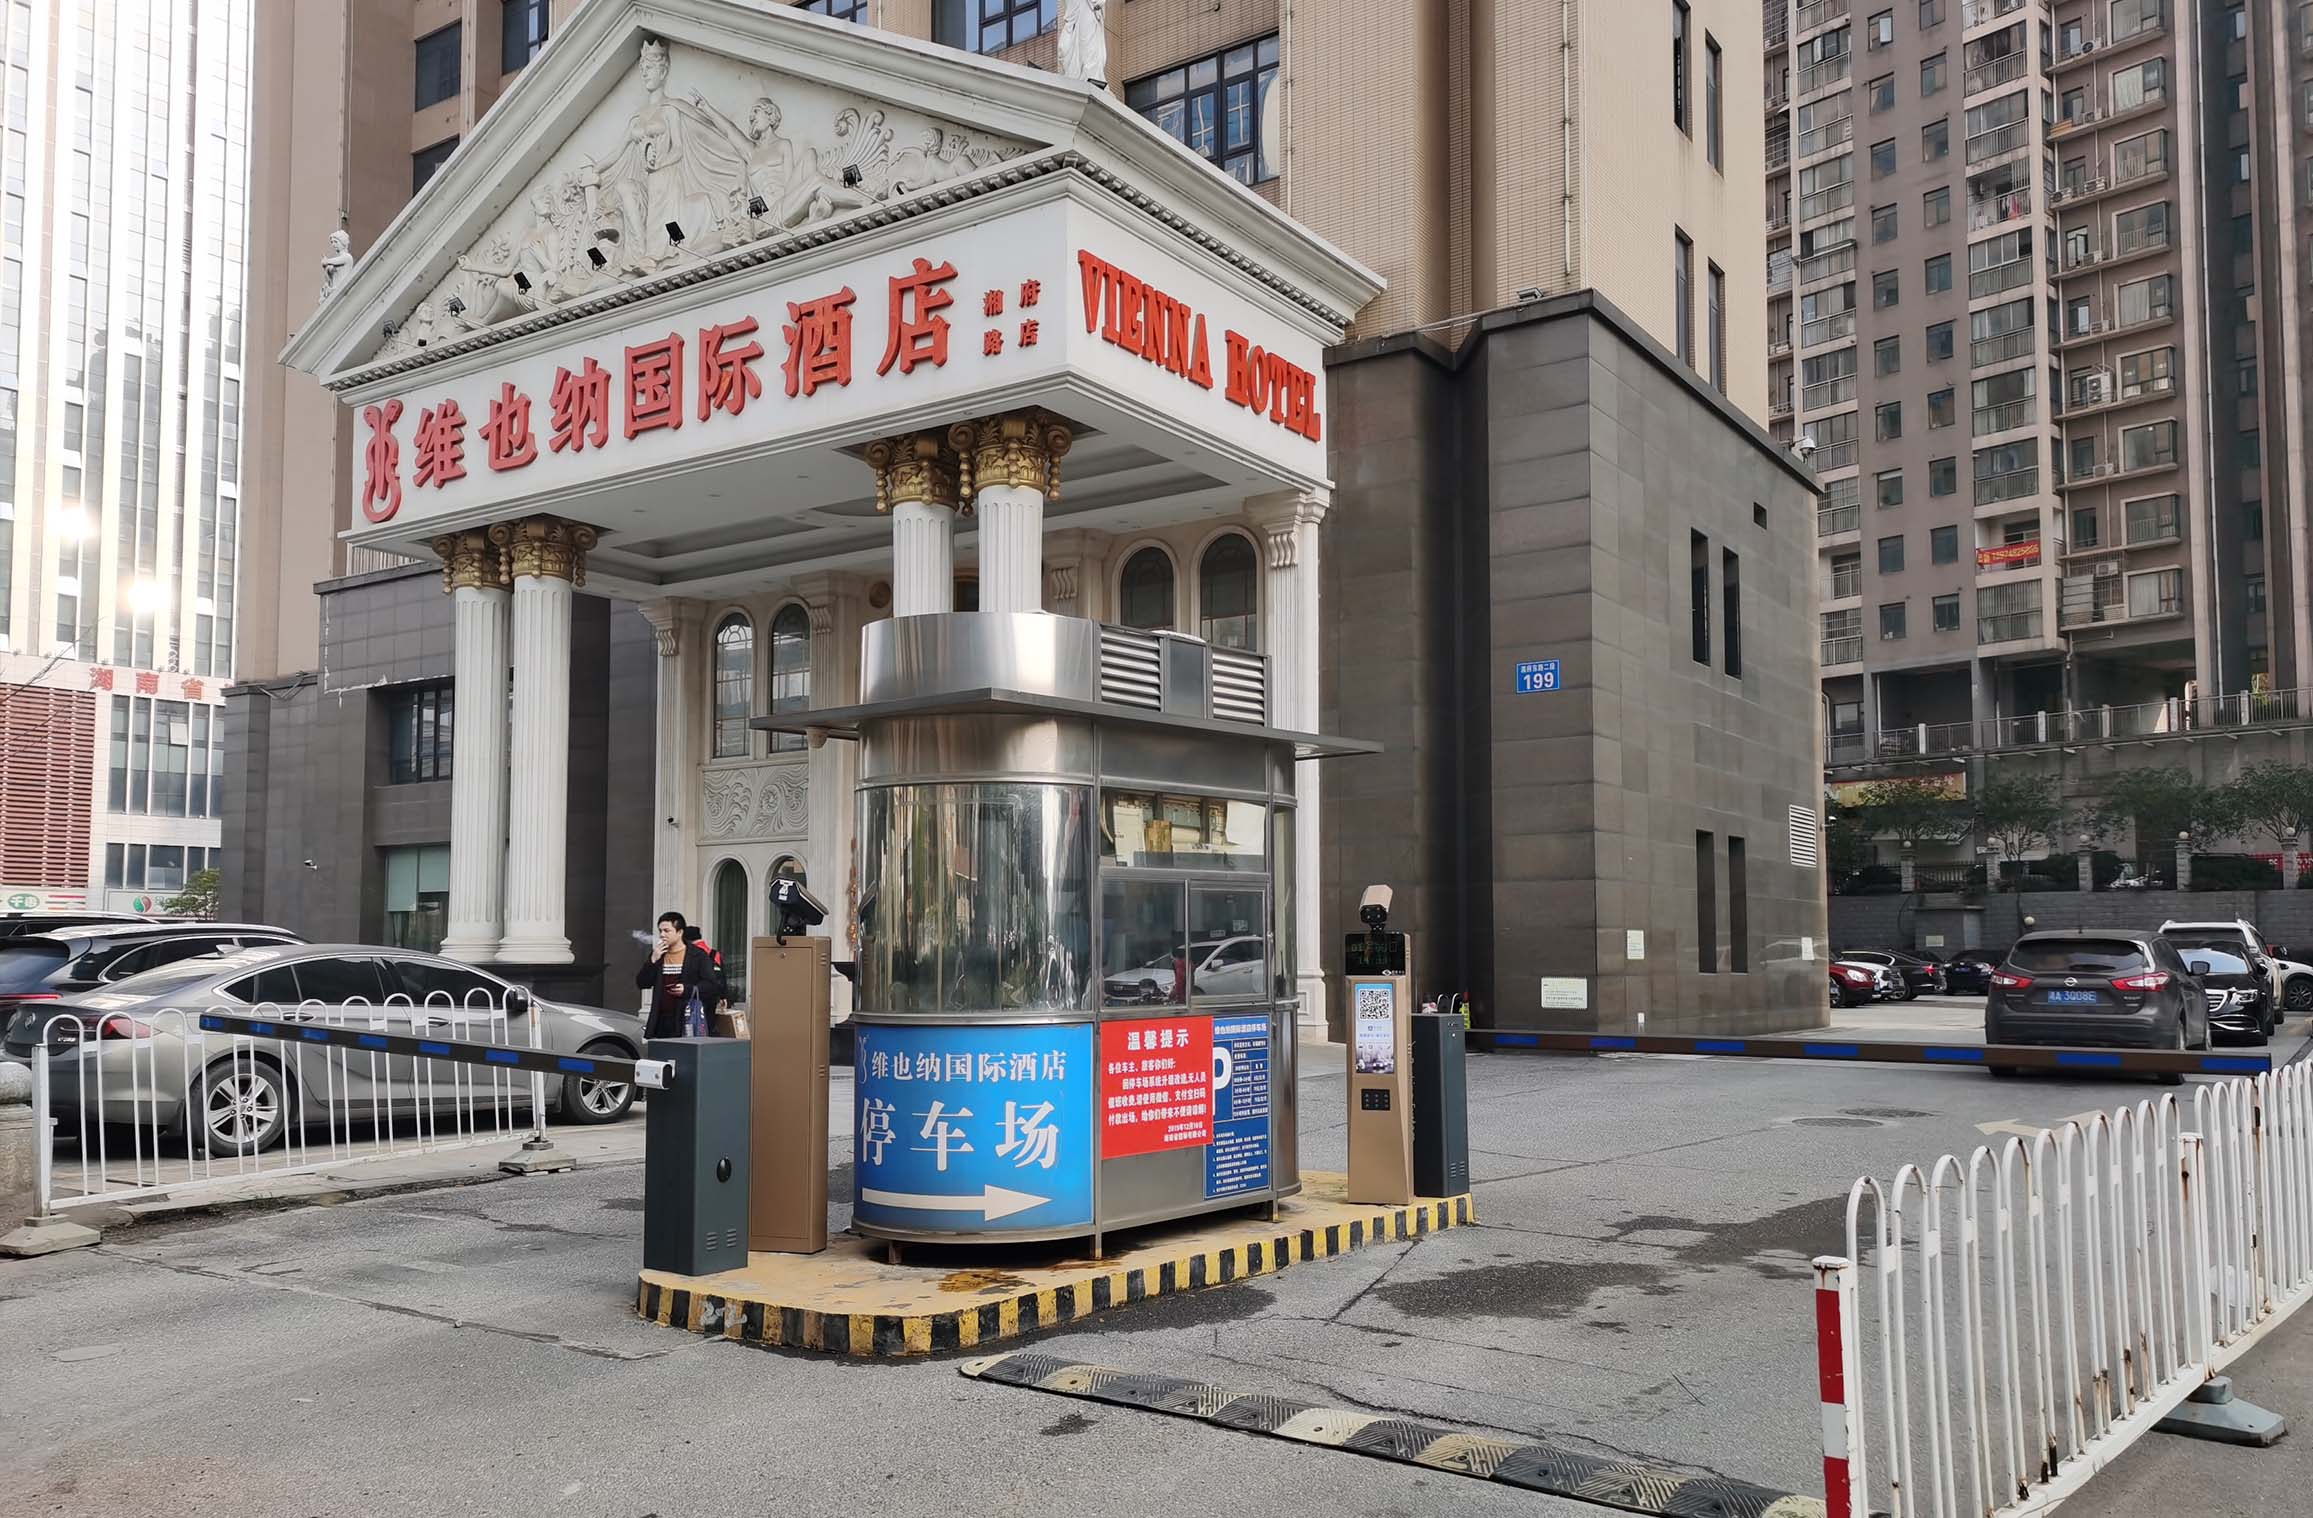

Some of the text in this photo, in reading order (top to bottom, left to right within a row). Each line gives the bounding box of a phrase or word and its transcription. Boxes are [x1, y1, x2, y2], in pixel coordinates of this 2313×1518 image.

[1078, 249, 1321, 442] VIENNA HOTEL
[413, 257, 957, 488] 维也纳国际酒店
[1523, 671, 1554, 690] 199
[1128, 1029, 1189, 1051] 温馨提示
[871, 1050, 1067, 1084] 维也纳国际酒店
[860, 1099, 1059, 1172] 停车场
